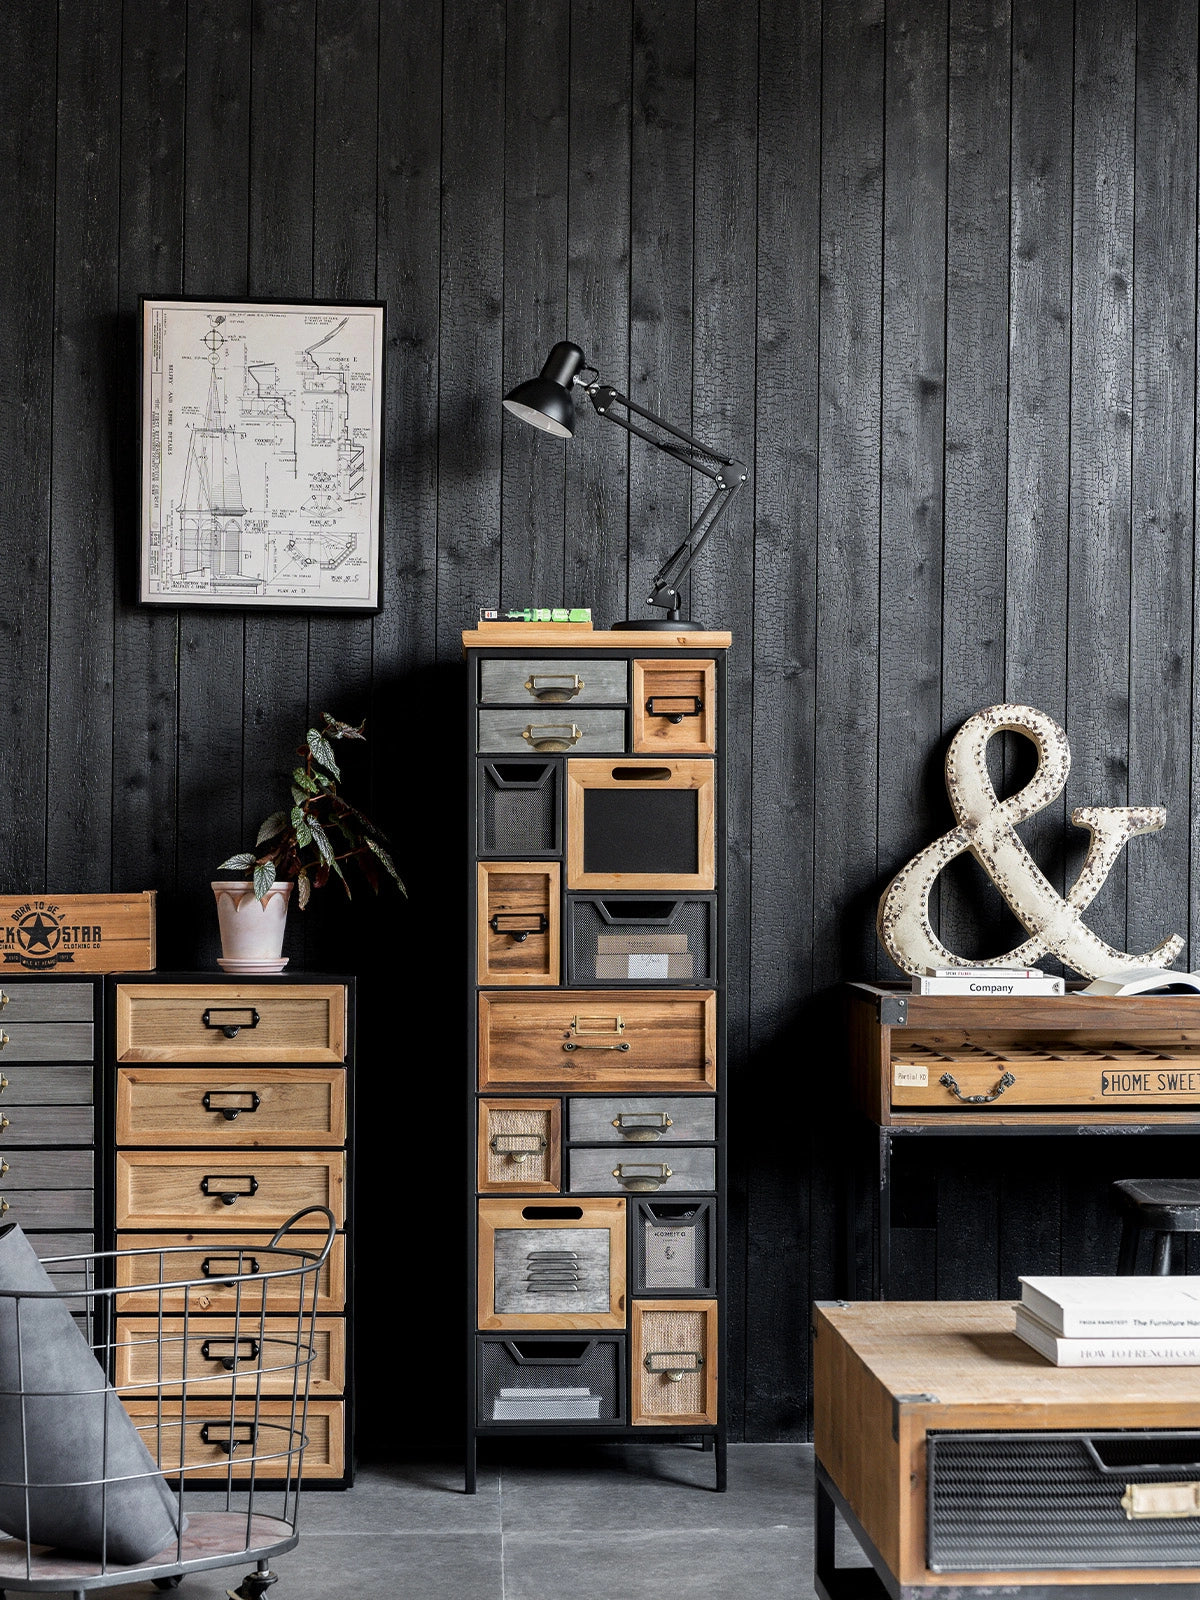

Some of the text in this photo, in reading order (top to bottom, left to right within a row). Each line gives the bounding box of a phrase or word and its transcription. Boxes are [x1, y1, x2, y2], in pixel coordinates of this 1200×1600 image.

[876, 704, 1186, 980] &
[11, 903, 32, 921] BORN
[34, 901, 45, 910] TO
[47, 904, 60, 915] BE
[62, 926, 102, 943] STAR
[970, 983, 1014, 994] Company
[1112, 1074, 1151, 1092] HOME
[1149, 1319, 1185, 1327] Furniture
[1080, 1349, 1105, 1358] HOW
[1111, 1350, 1126, 1358] TO
[1128, 1349, 1173, 1358] FRENCH
